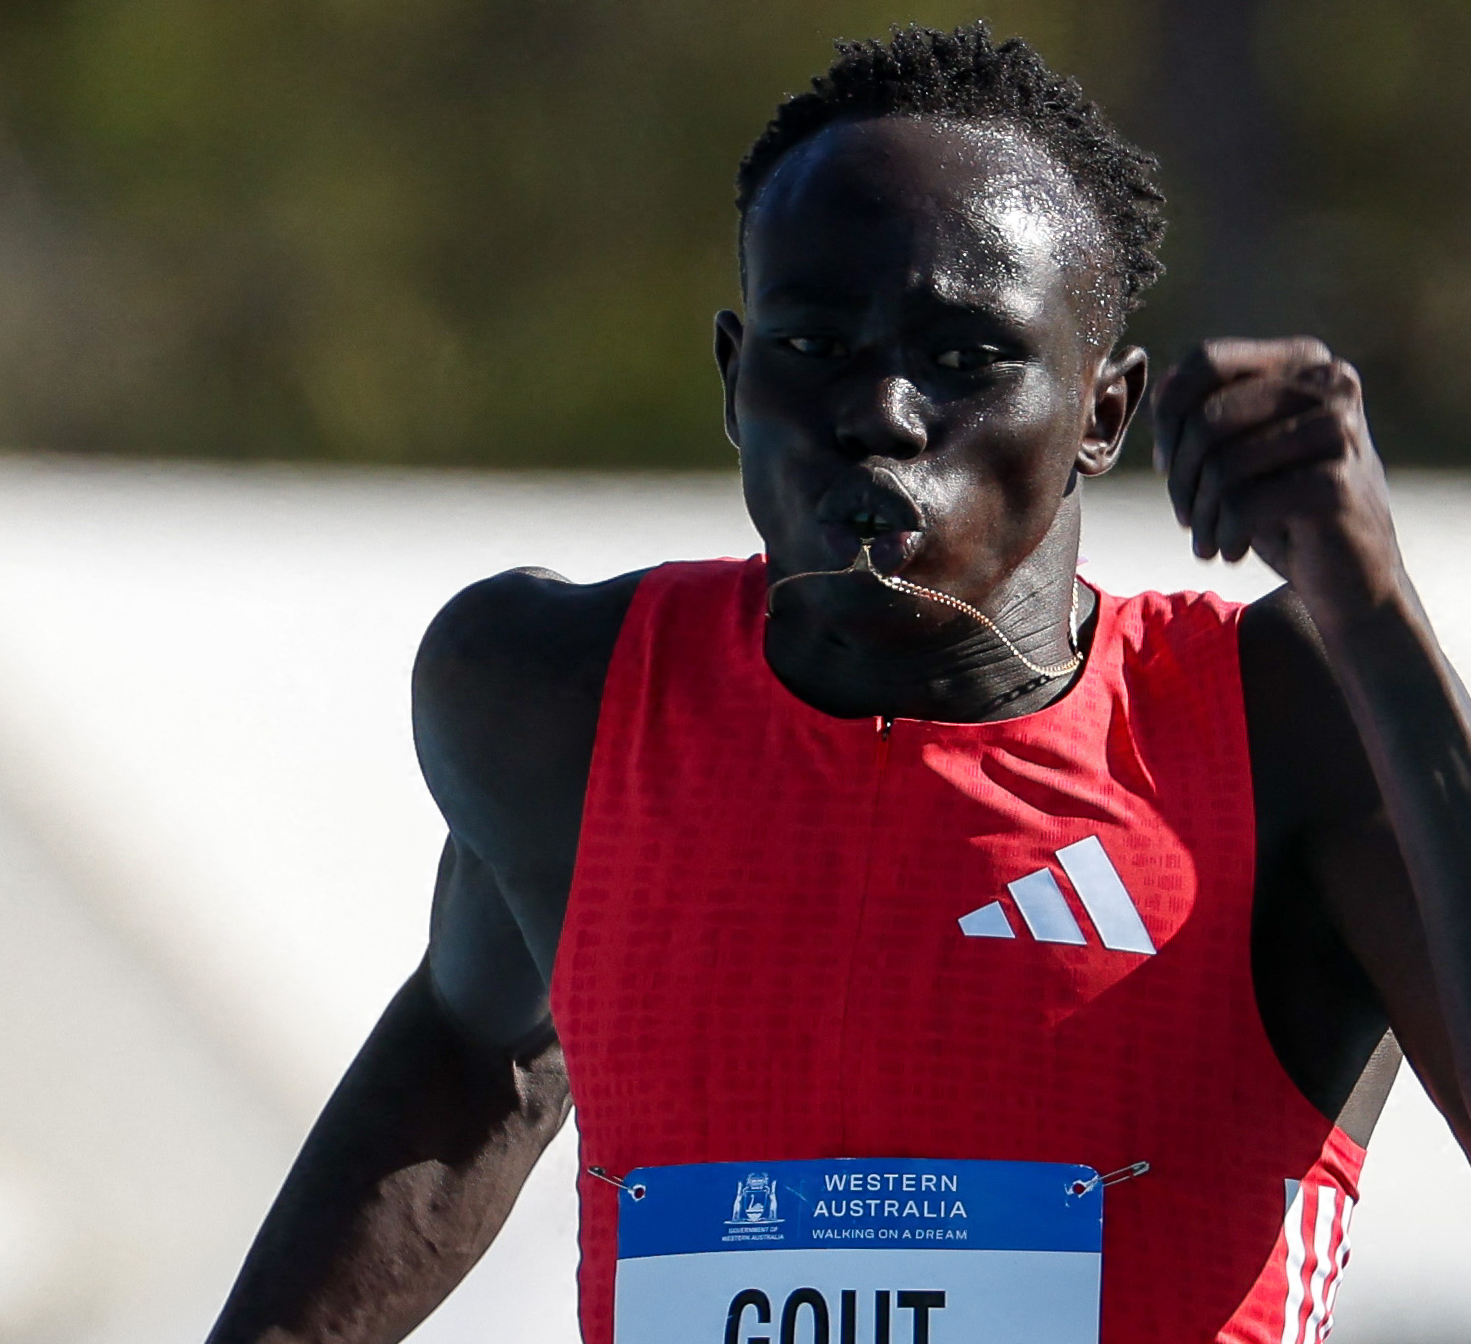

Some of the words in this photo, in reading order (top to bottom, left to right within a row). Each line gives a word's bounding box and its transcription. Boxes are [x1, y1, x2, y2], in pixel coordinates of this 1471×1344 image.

[824, 1174, 958, 1192] WESTERN
[812, 1200, 968, 1218] AUSTRALIA
[812, 1228, 874, 1240] WALKING
[878, 1229, 898, 1240] ON
[902, 1229, 911, 1240] A
[915, 1229, 968, 1240] DREAM
